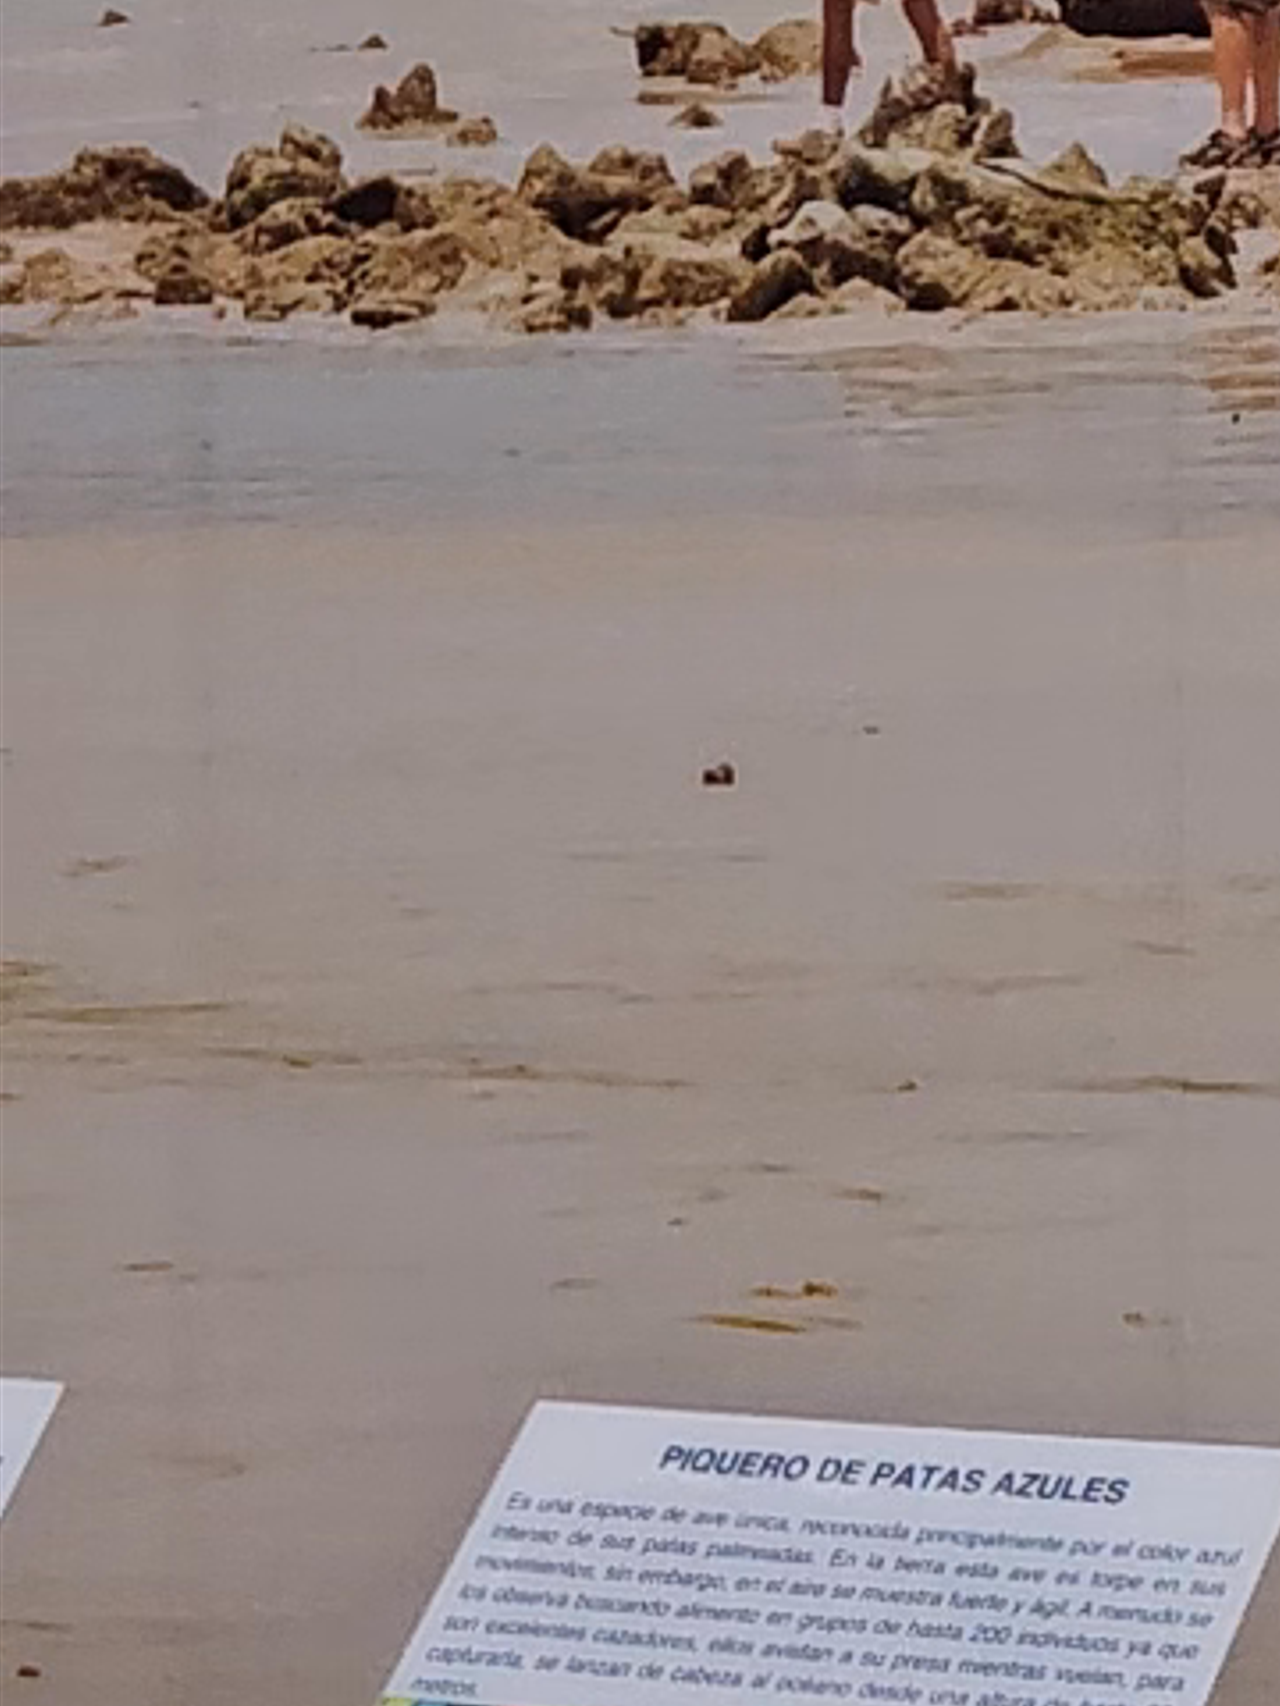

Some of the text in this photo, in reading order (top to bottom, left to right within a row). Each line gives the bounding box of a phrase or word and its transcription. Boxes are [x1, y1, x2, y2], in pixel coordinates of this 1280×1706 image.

[657, 1444, 1131, 1506] PIQUERO DE PATAS AZULES
